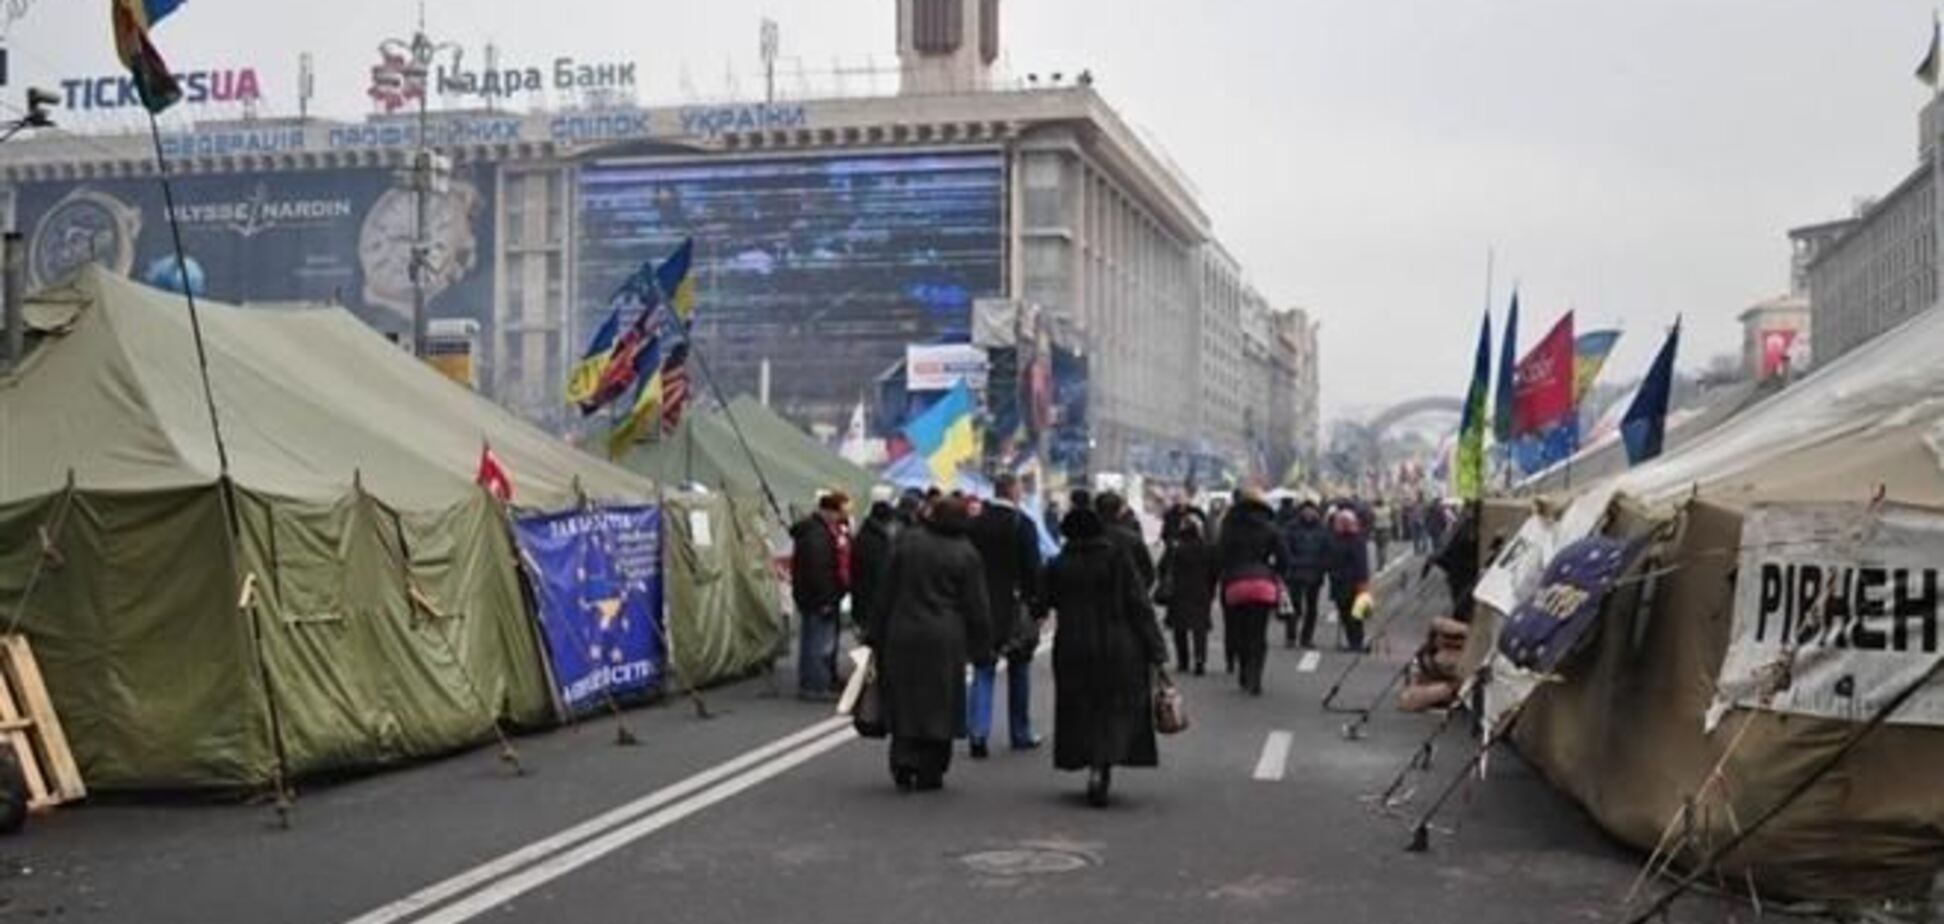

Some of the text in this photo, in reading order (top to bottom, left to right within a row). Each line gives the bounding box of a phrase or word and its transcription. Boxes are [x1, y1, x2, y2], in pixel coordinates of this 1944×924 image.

[553, 58, 637, 89] Банк
[680, 105, 807, 133] УКРАЇНИ
[164, 199, 351, 222] ULYSSE NARDIN
[1755, 563, 1937, 653] РІВНЕН
